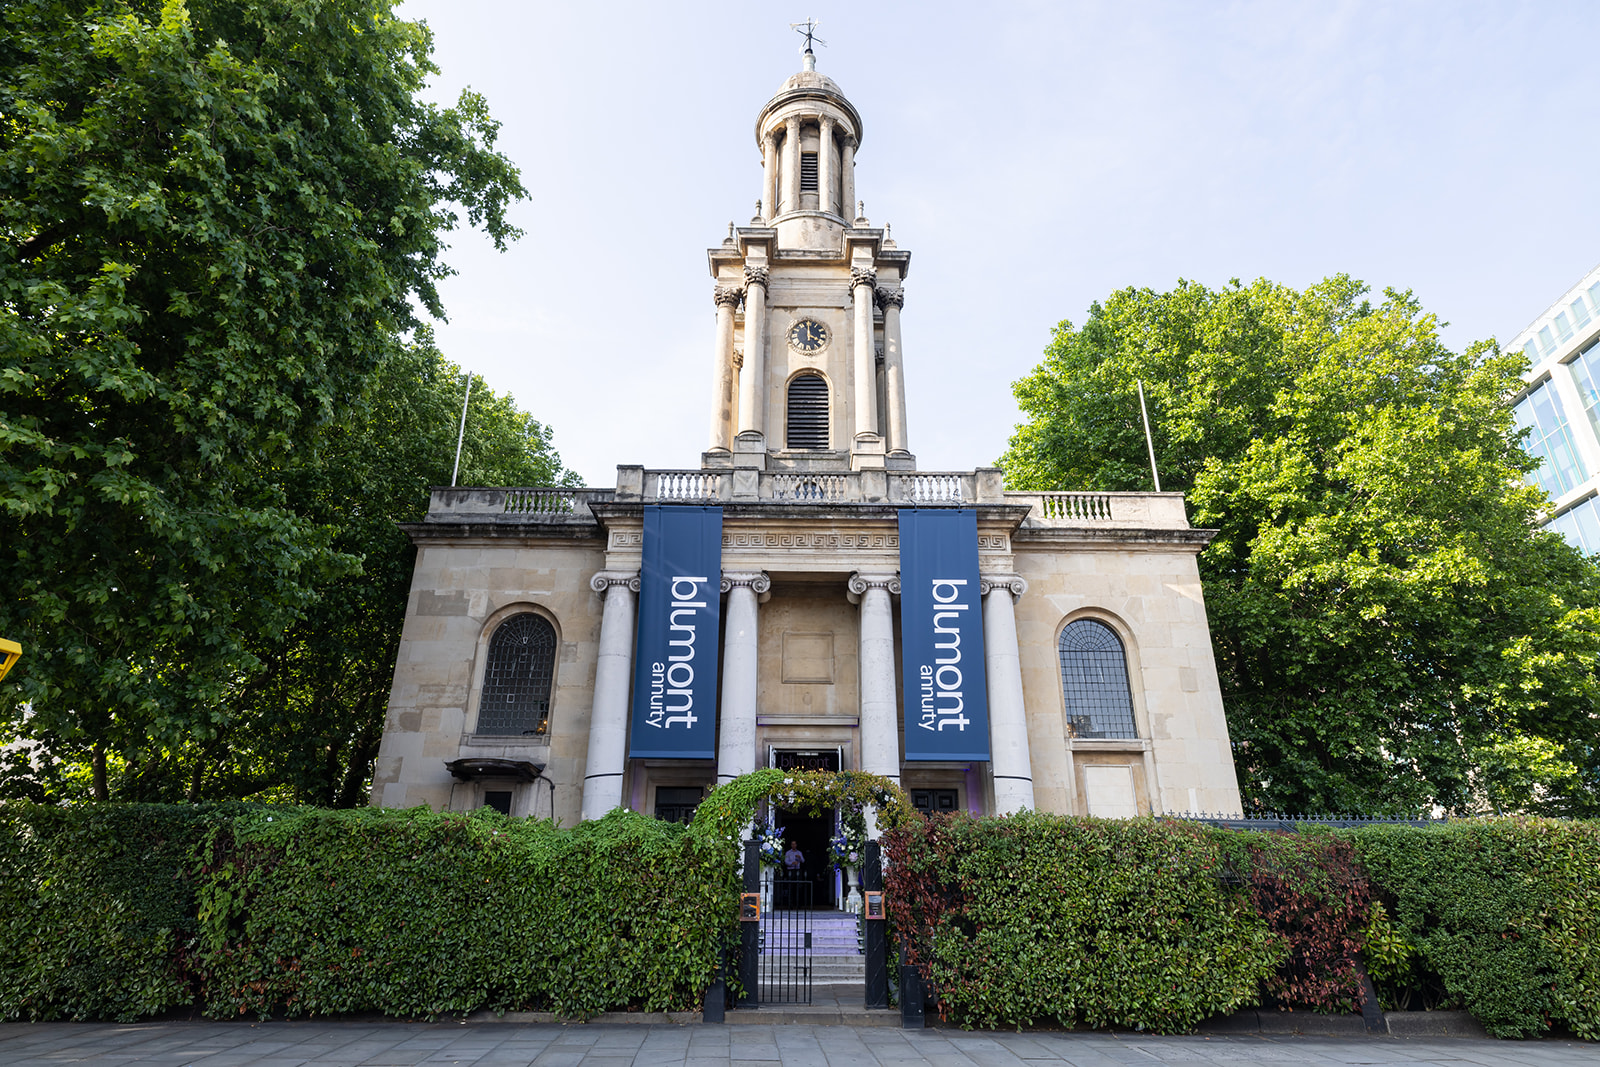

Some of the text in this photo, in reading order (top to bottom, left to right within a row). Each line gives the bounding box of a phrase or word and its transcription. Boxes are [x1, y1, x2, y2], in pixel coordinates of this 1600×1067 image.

[645, 662, 665, 729] annuity
[664, 576, 708, 729] blumont
[918, 664, 937, 731] annuity
[932, 579, 970, 732] blumont
